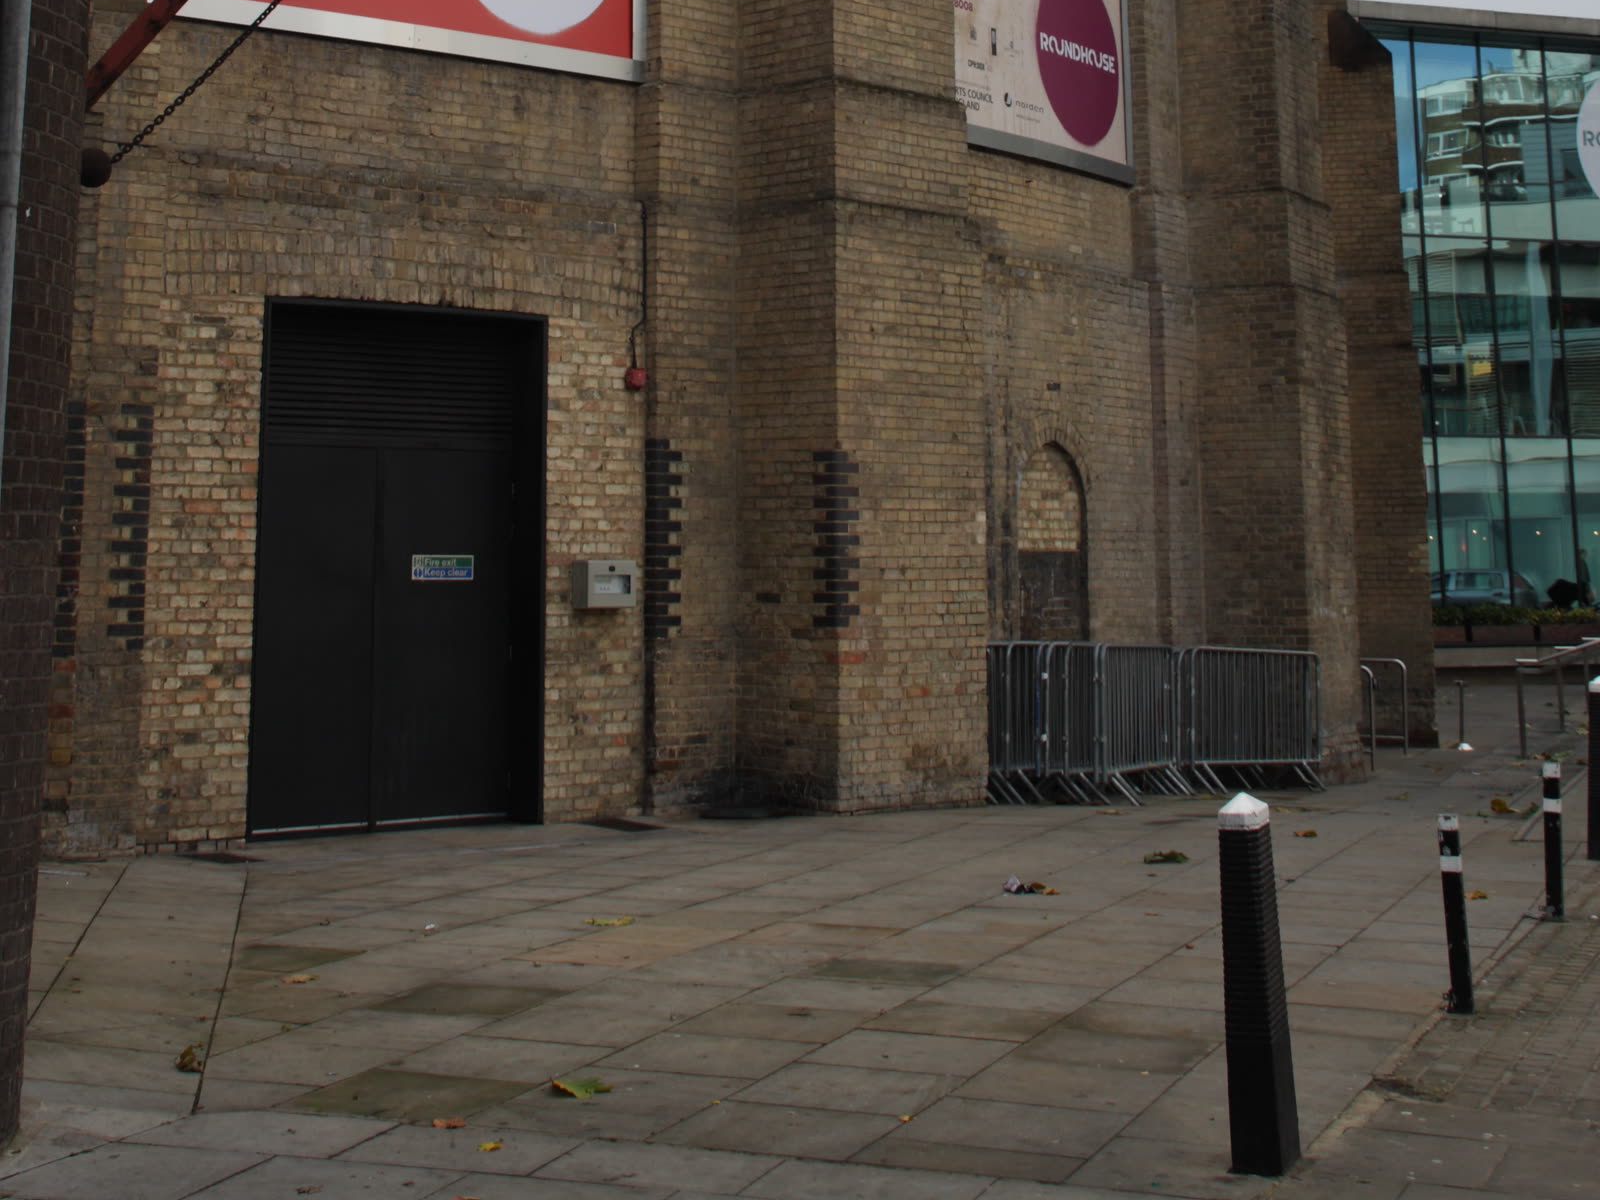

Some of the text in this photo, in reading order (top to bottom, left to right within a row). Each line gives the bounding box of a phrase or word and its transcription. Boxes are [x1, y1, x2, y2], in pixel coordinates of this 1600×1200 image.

[1039, 31, 1116, 74] ROUNDHOUSE
[967, 89, 994, 104] COUNCIL
[424, 567, 467, 578] Keep clear
